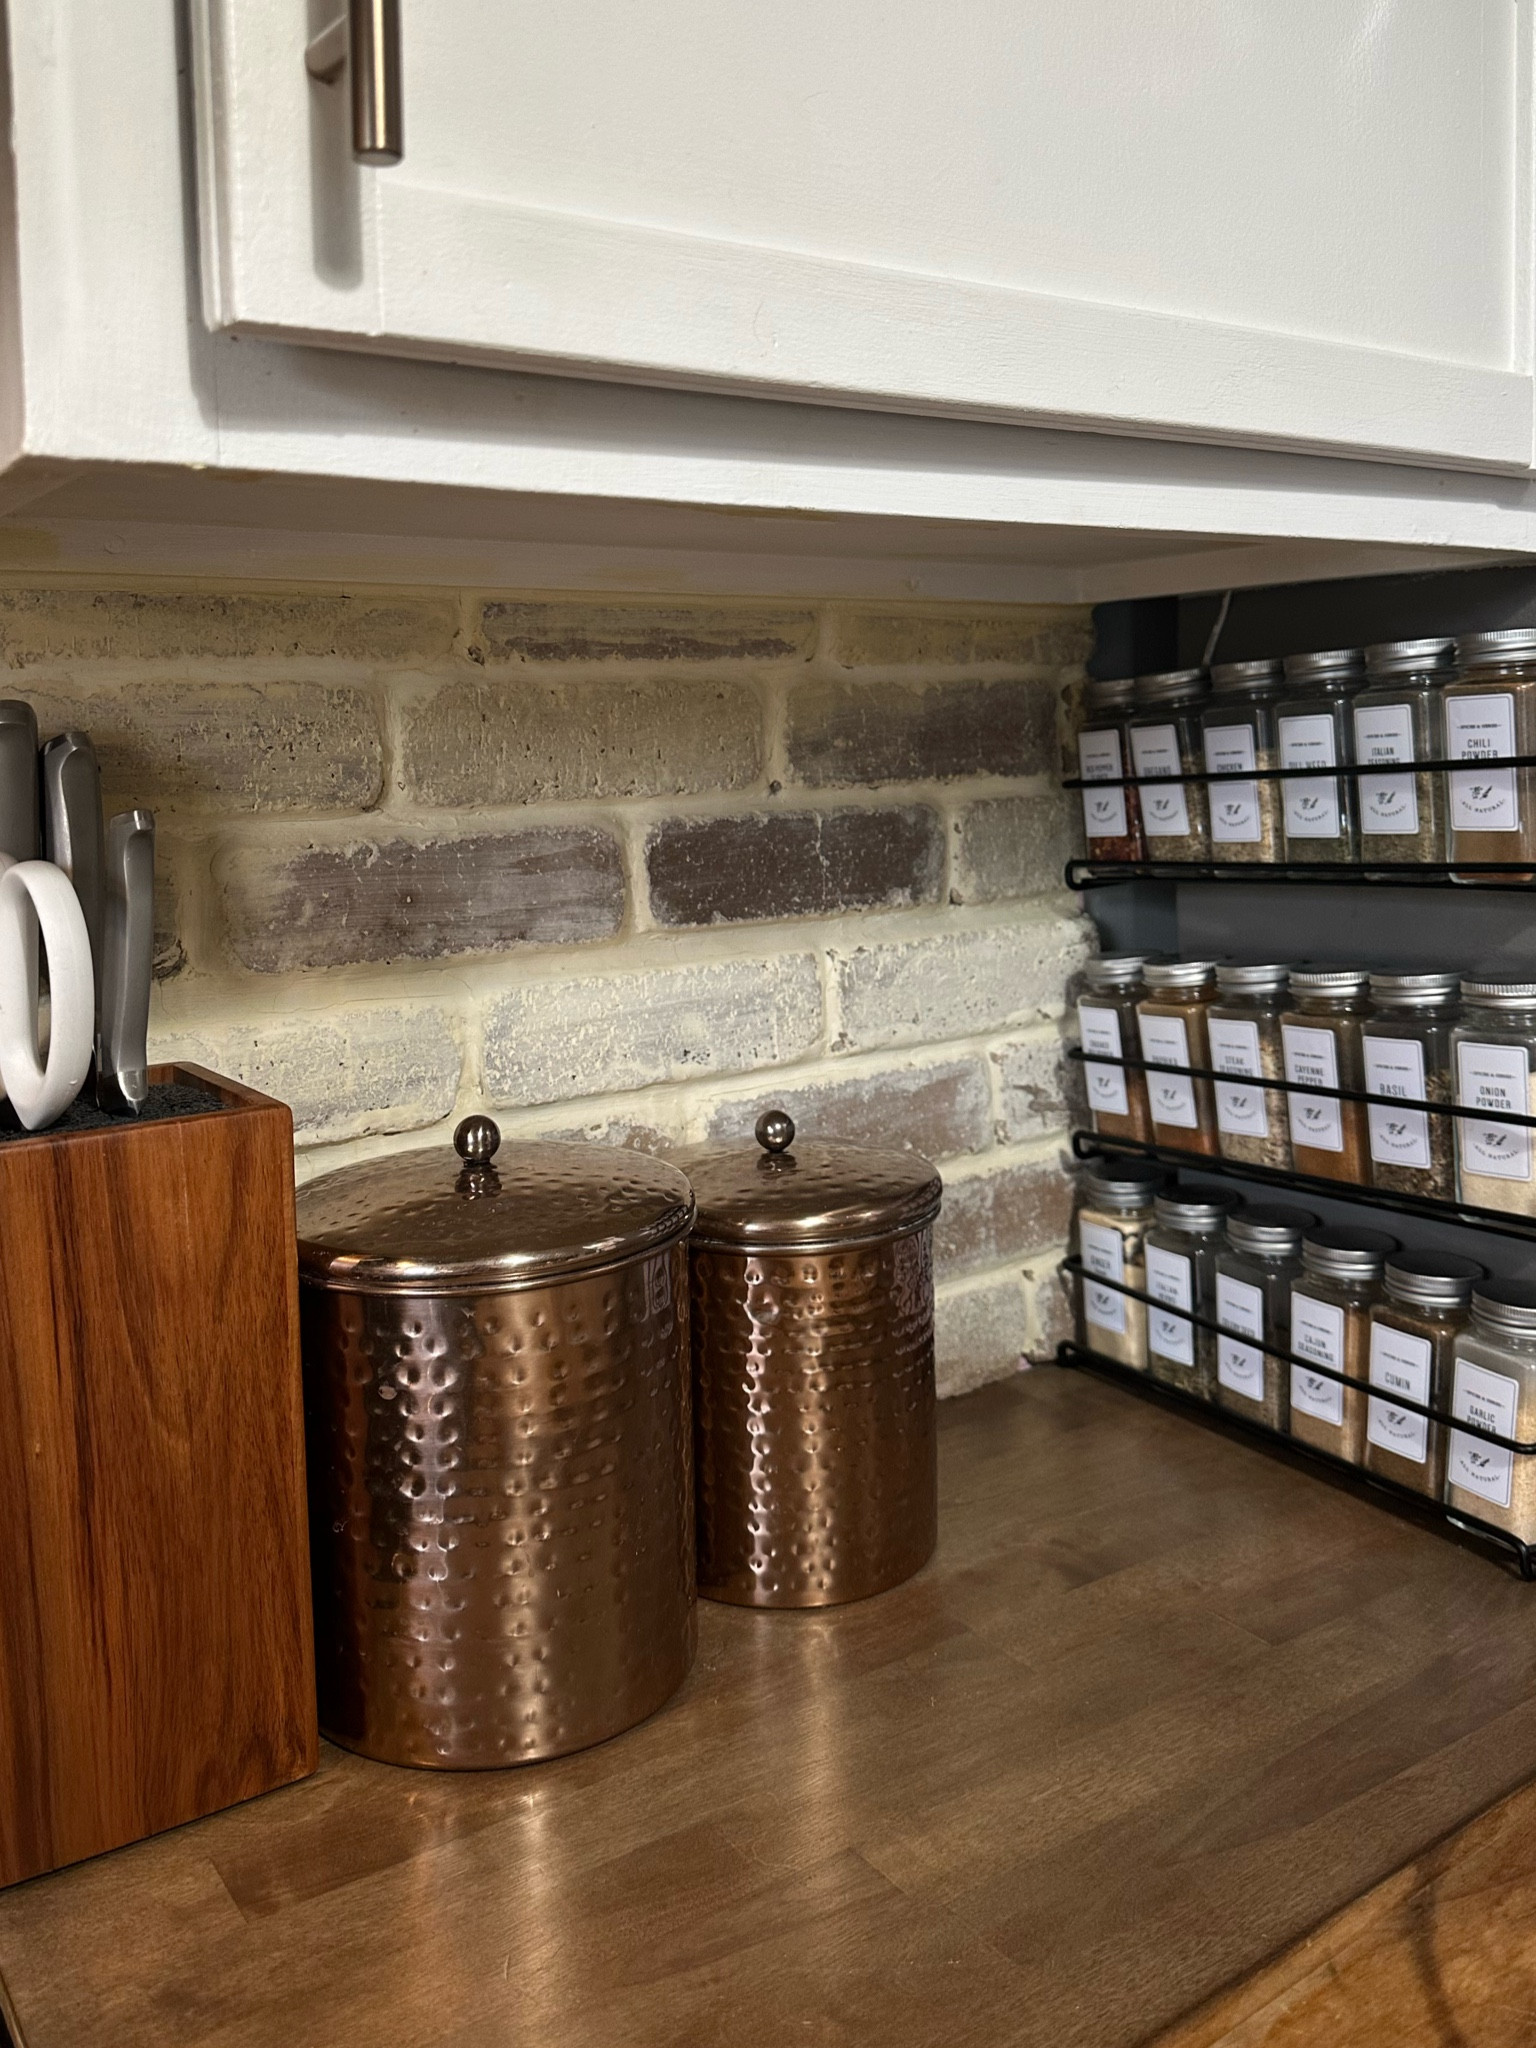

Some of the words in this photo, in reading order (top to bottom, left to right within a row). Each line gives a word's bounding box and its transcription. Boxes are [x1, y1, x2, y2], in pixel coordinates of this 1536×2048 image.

[1467, 738, 1490, 749] CHILI
[1371, 747, 1394, 756] ITALIAN
[1461, 750, 1498, 760] POWDER
[1217, 763, 1243, 772] CHICKEN
[1294, 1064, 1323, 1076] CAYENNE
[1297, 1074, 1323, 1087] PEPPER
[1379, 1083, 1407, 1097] BASIL
[1479, 1085, 1506, 1097] ONION
[1475, 1096, 1512, 1109] POWDER
[1304, 1333, 1326, 1349] CAJUN
[1385, 1371, 1411, 1390] CUMIN
[1470, 1404, 1496, 1424] GARLIC
[1467, 1415, 1497, 1434] POWDER
